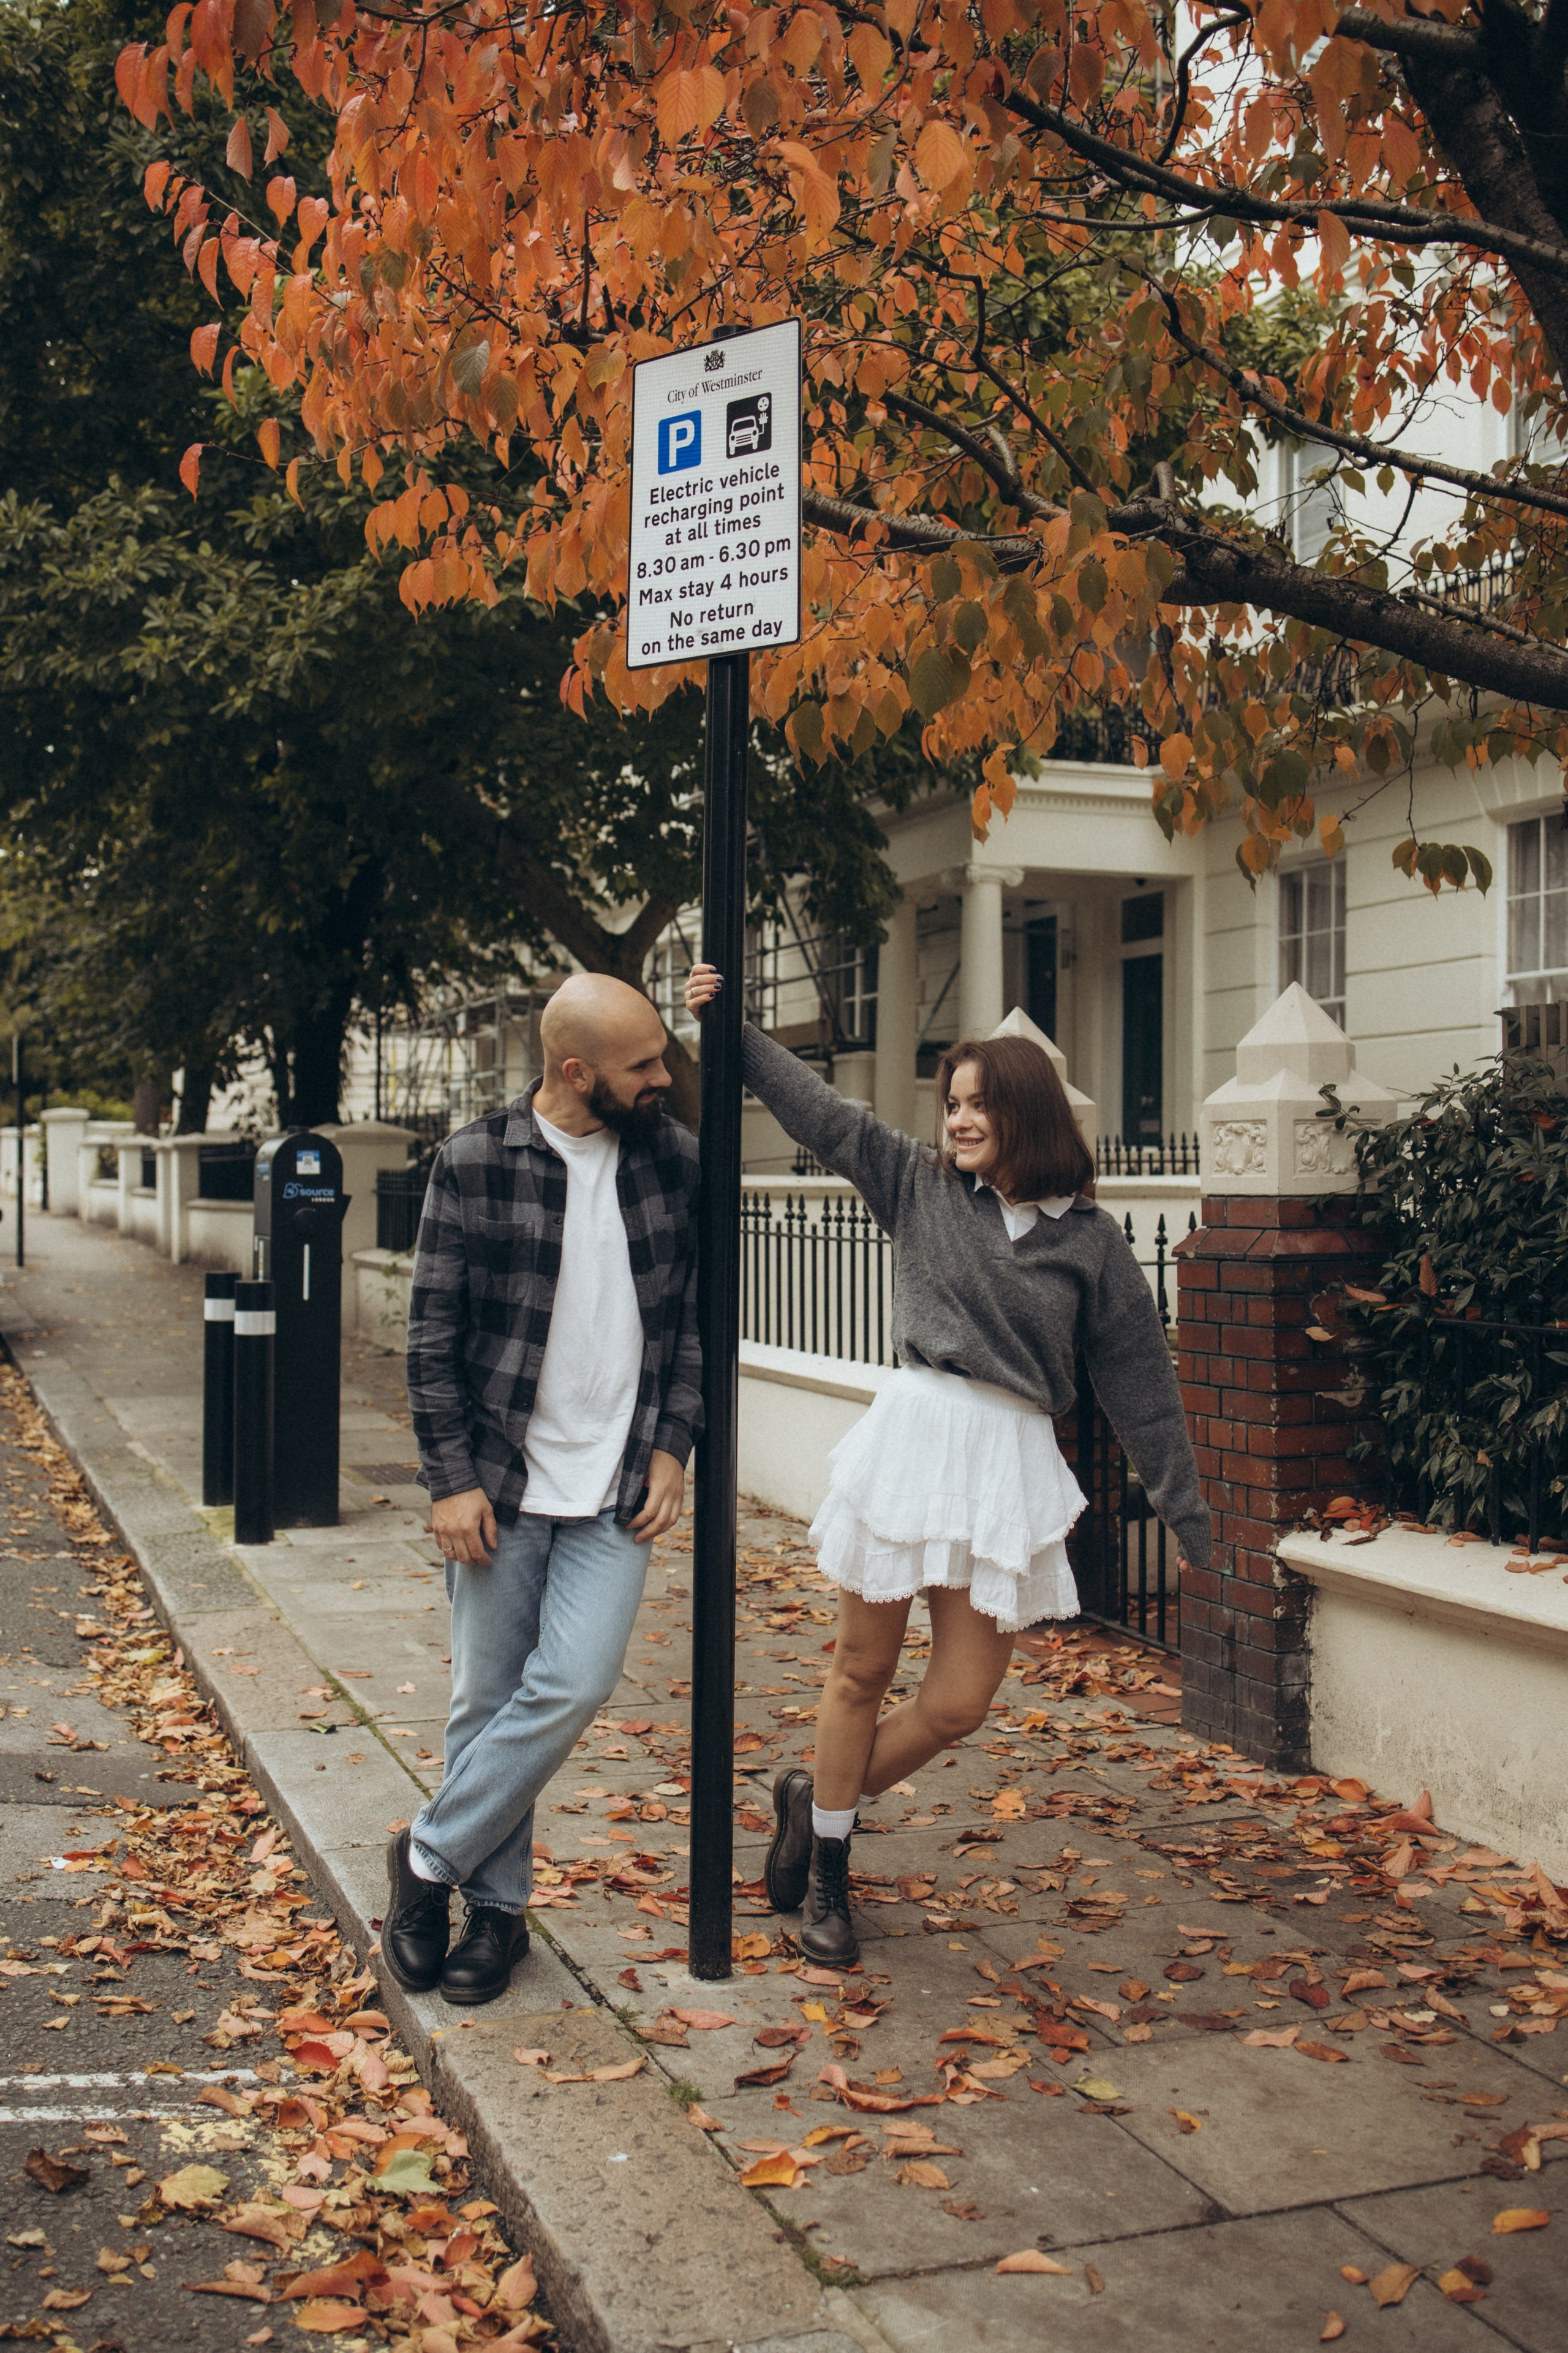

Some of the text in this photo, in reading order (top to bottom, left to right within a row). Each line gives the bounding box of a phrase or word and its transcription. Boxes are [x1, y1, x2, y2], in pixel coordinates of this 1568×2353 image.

[668, 369, 763, 404] City of Westminster
[669, 419, 695, 467] P
[650, 462, 780, 505] Electric vehicle
[644, 482, 785, 528] recharging point
[665, 515, 761, 546] at all times
[637, 556, 676, 579] 8.30
[680, 554, 704, 571] am
[719, 539, 760, 563] 6.30
[765, 537, 791, 558] pm
[639, 567, 788, 606] Max stay 4 hours
[670, 602, 753, 629] No return
[641, 619, 783, 655] on the same day
